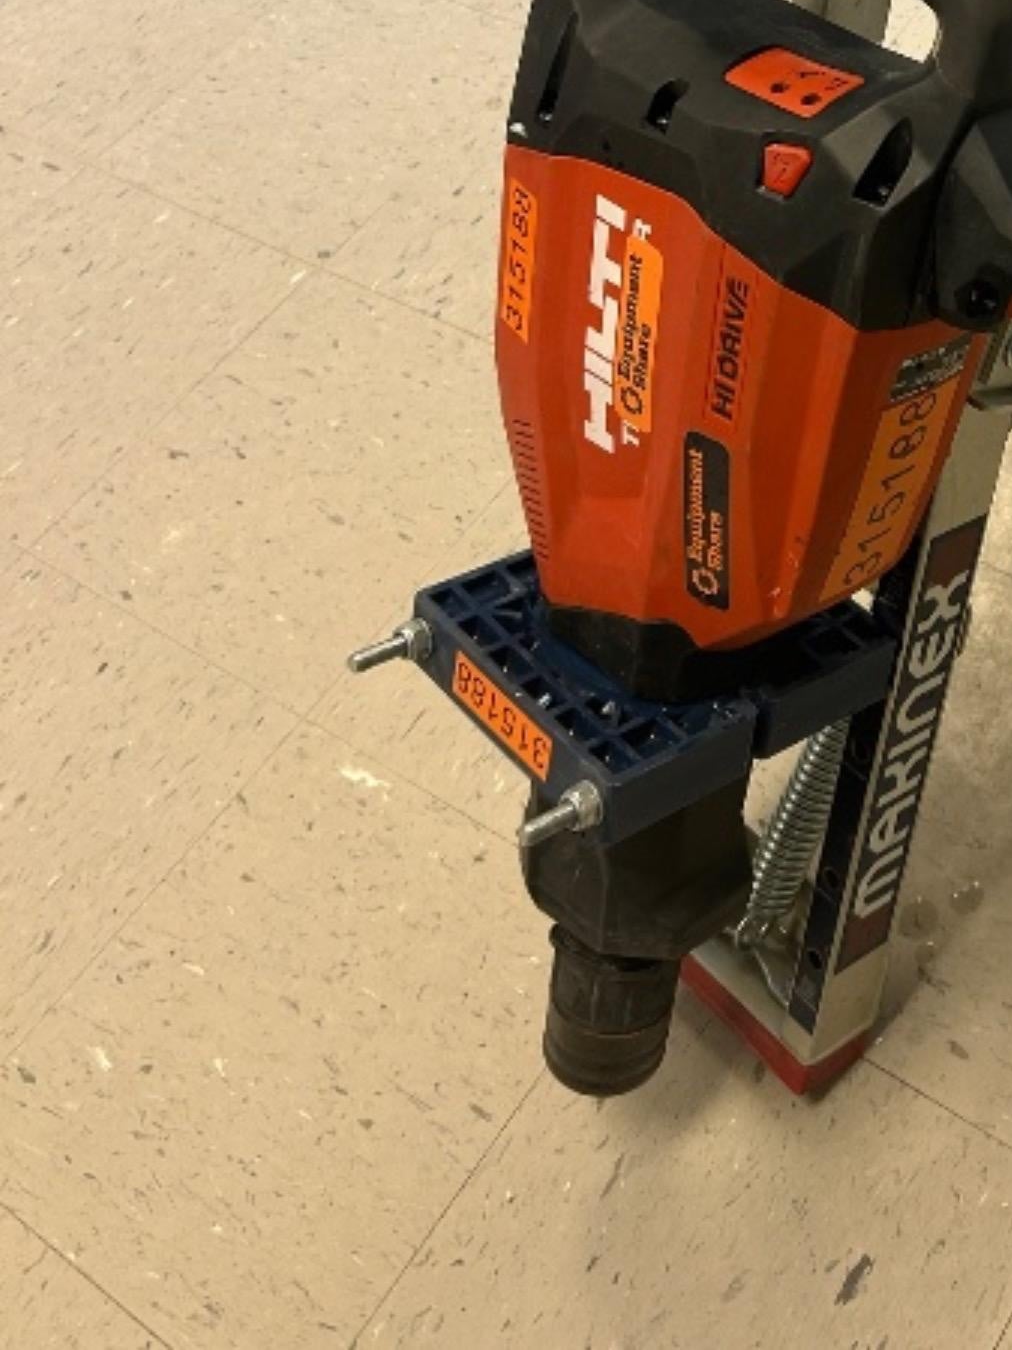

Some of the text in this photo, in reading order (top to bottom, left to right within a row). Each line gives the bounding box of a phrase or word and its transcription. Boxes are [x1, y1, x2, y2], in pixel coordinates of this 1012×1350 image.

[584, 193, 627, 454] HILTI
[618, 253, 643, 382] Equipment
[633, 323, 652, 391] Share
[687, 449, 706, 563] Equipment
[706, 511, 725, 572] Share
[843, 392, 938, 586] 315188
[456, 661, 548, 770] 315188
[853, 569, 969, 920] MAKINEX
